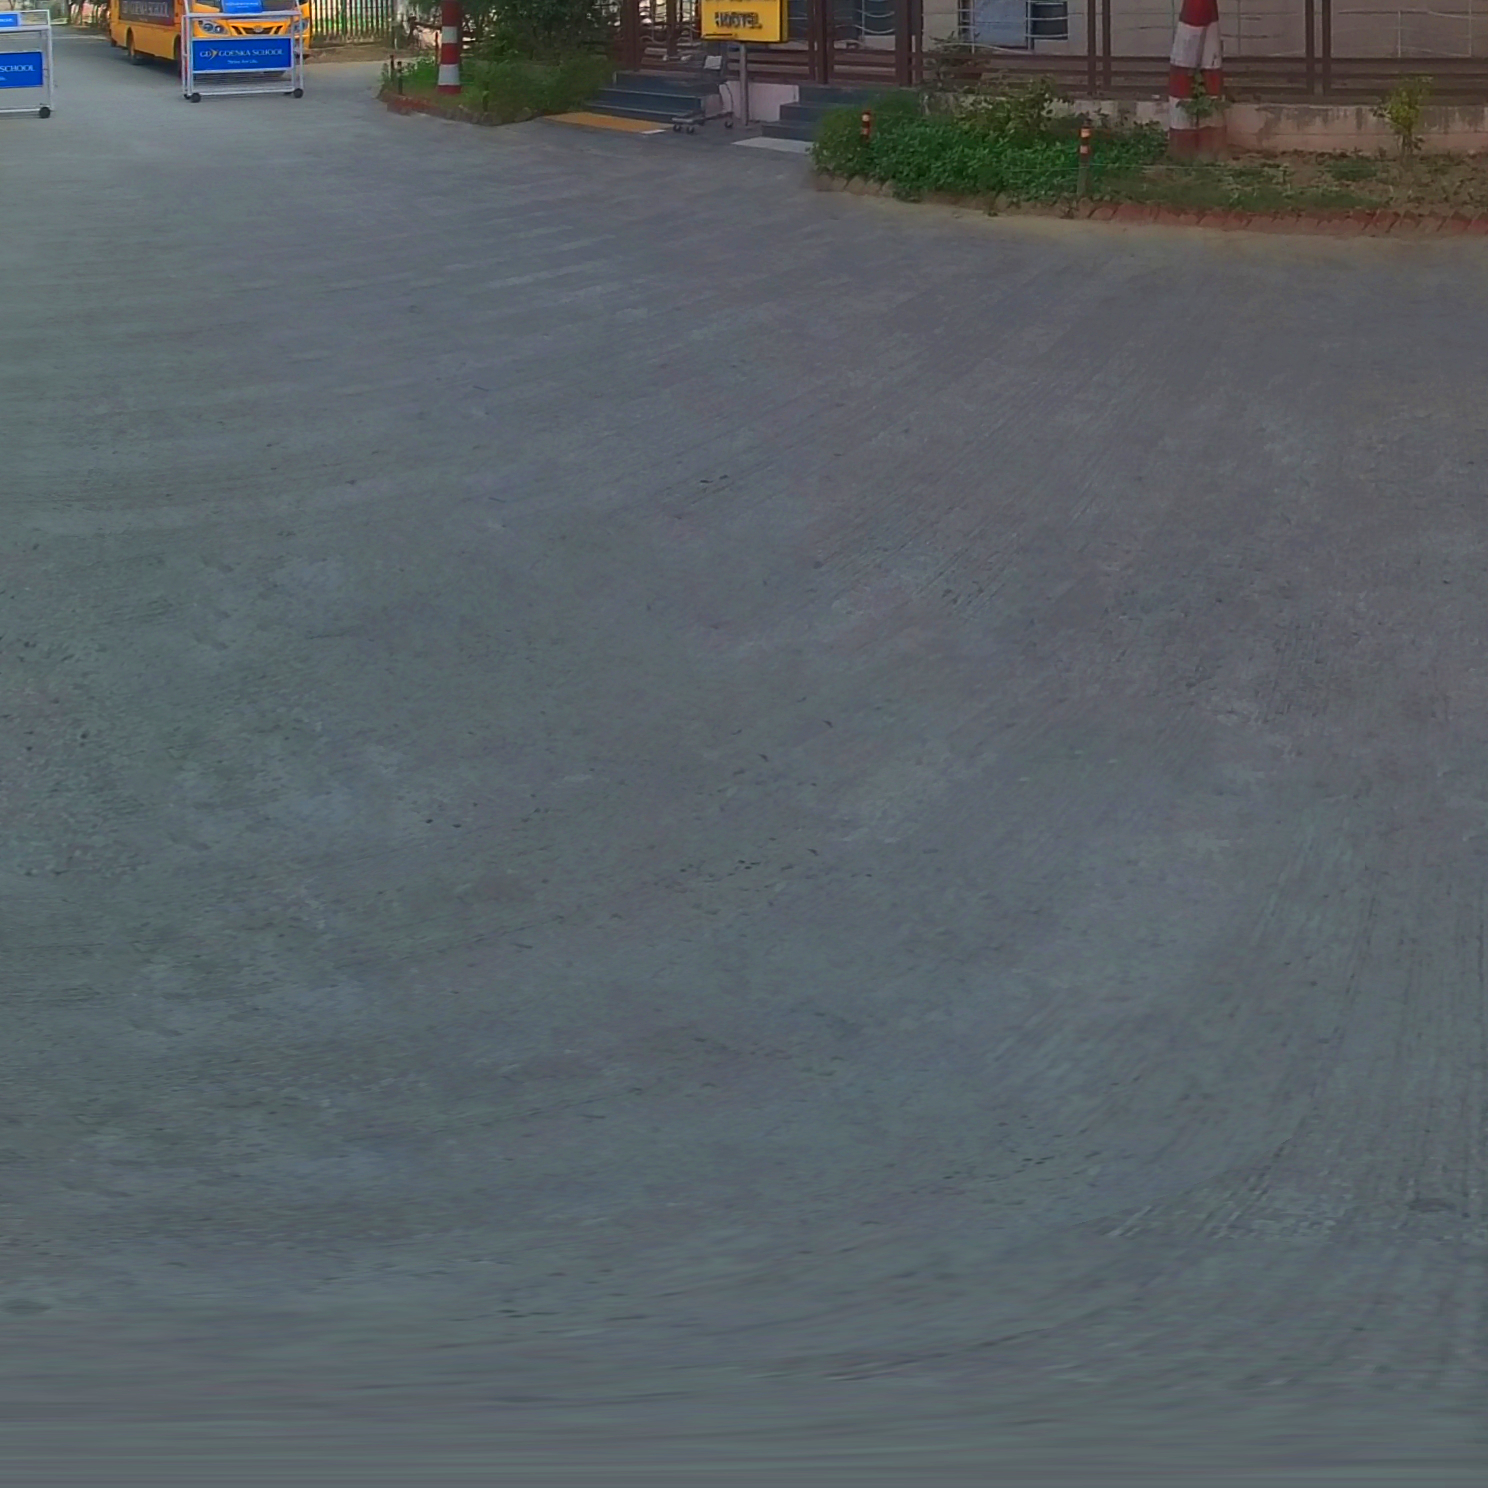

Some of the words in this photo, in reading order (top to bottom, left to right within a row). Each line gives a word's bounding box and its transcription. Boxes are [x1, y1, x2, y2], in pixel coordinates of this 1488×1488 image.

[218, 49, 251, 57] GOENKA
[252, 48, 283, 56] SCHOOL
[0, 64, 35, 72] SCHOOL
